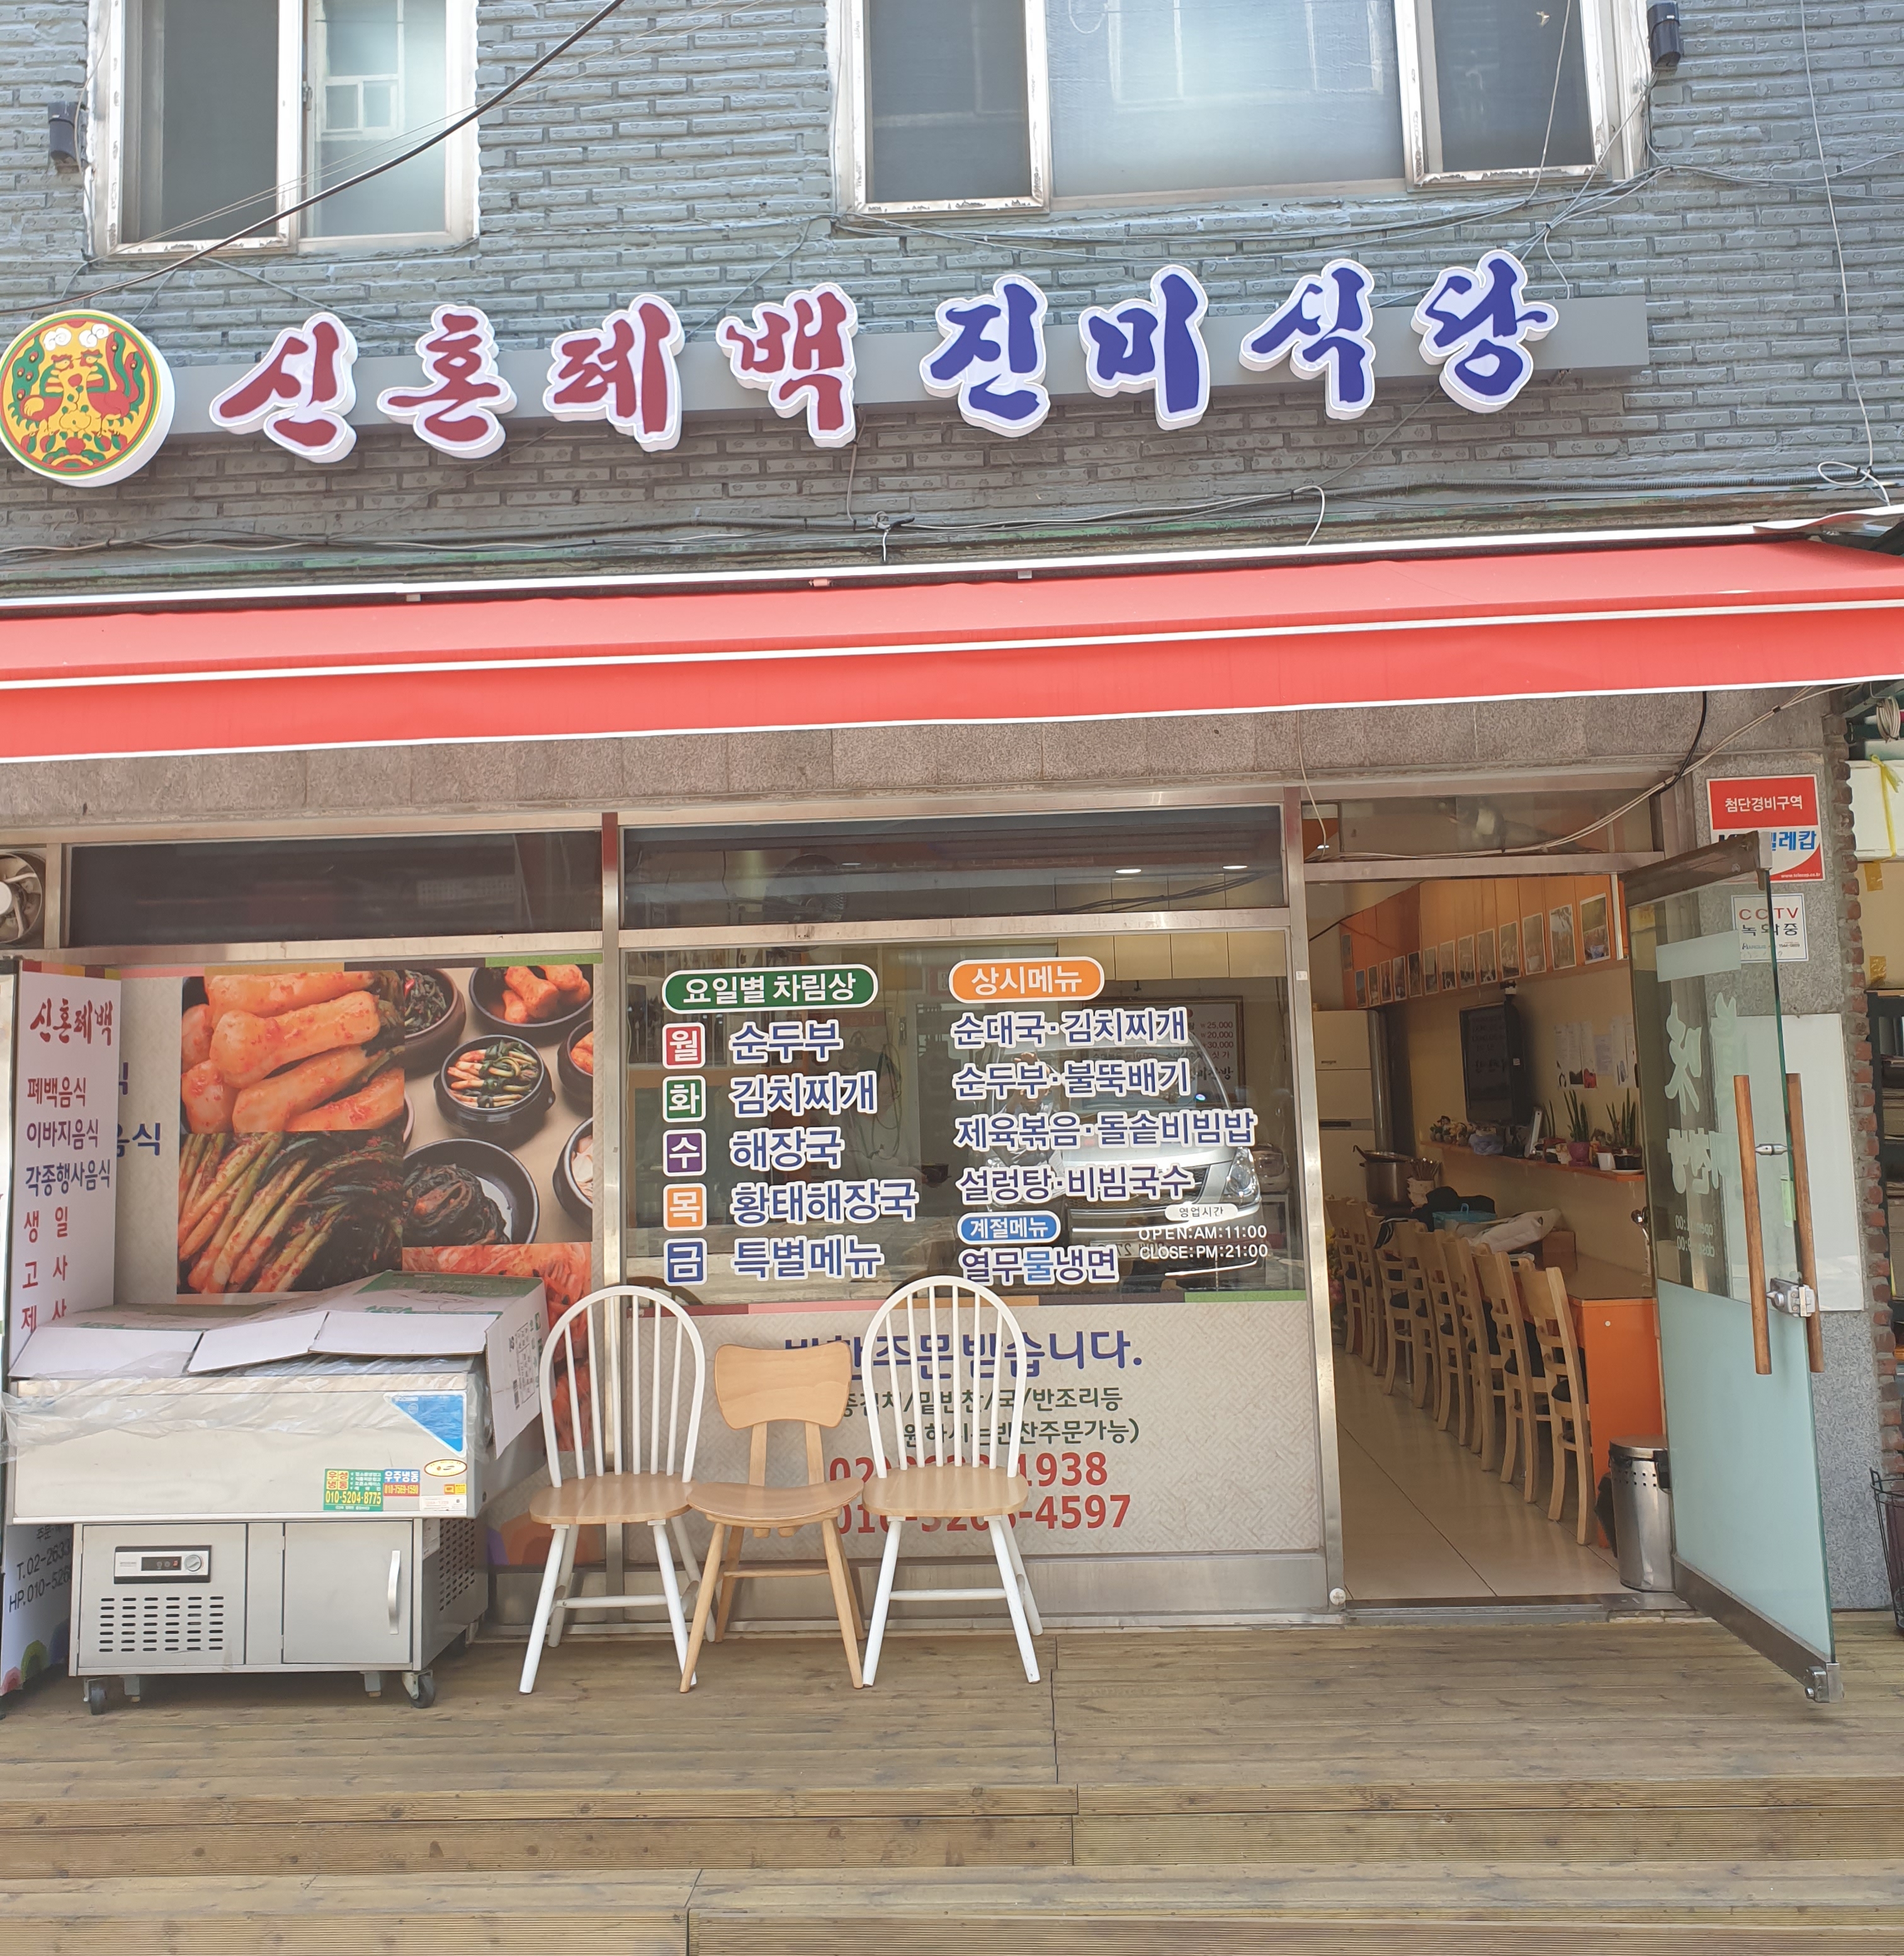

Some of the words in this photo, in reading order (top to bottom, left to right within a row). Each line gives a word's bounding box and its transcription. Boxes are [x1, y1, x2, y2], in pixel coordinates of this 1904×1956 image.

[924, 254, 1553, 428] 진미식당
[1725, 795, 1803, 812] 첨단경비구역
[1739, 907, 1798, 920] CCTV
[683, 975, 766, 1004] 요일별
[773, 972, 856, 1003] 차림상
[972, 965, 1083, 995] 상시메뉴
[669, 1029, 698, 1062] 월
[730, 1021, 842, 1062] 순두부
[27, 1077, 87, 1108] 폐백음식
[669, 1083, 700, 1115] 화
[730, 1072, 876, 1115] 김치찌개
[26, 1118, 99, 1150] 이바지음식
[669, 1136, 700, 1169] 수
[731, 1129, 843, 1169] 해장국
[25, 1159, 111, 1197] 각종행사음식
[669, 1191, 701, 1223] 목
[732, 1180, 918, 1225] 황태해장국
[1179, 1206, 1223, 1218] 영업시간
[970, 1218, 1049, 1239] 계절메뉴
[668, 1244, 701, 1279] 금
[732, 1236, 883, 1280] 특별메뉴
[961, 1246, 1117, 1283] 열무물냉면
[785, 1330, 1142, 1380] 주문받습니다.
[385, 1470, 419, 1482] 우주냉동
